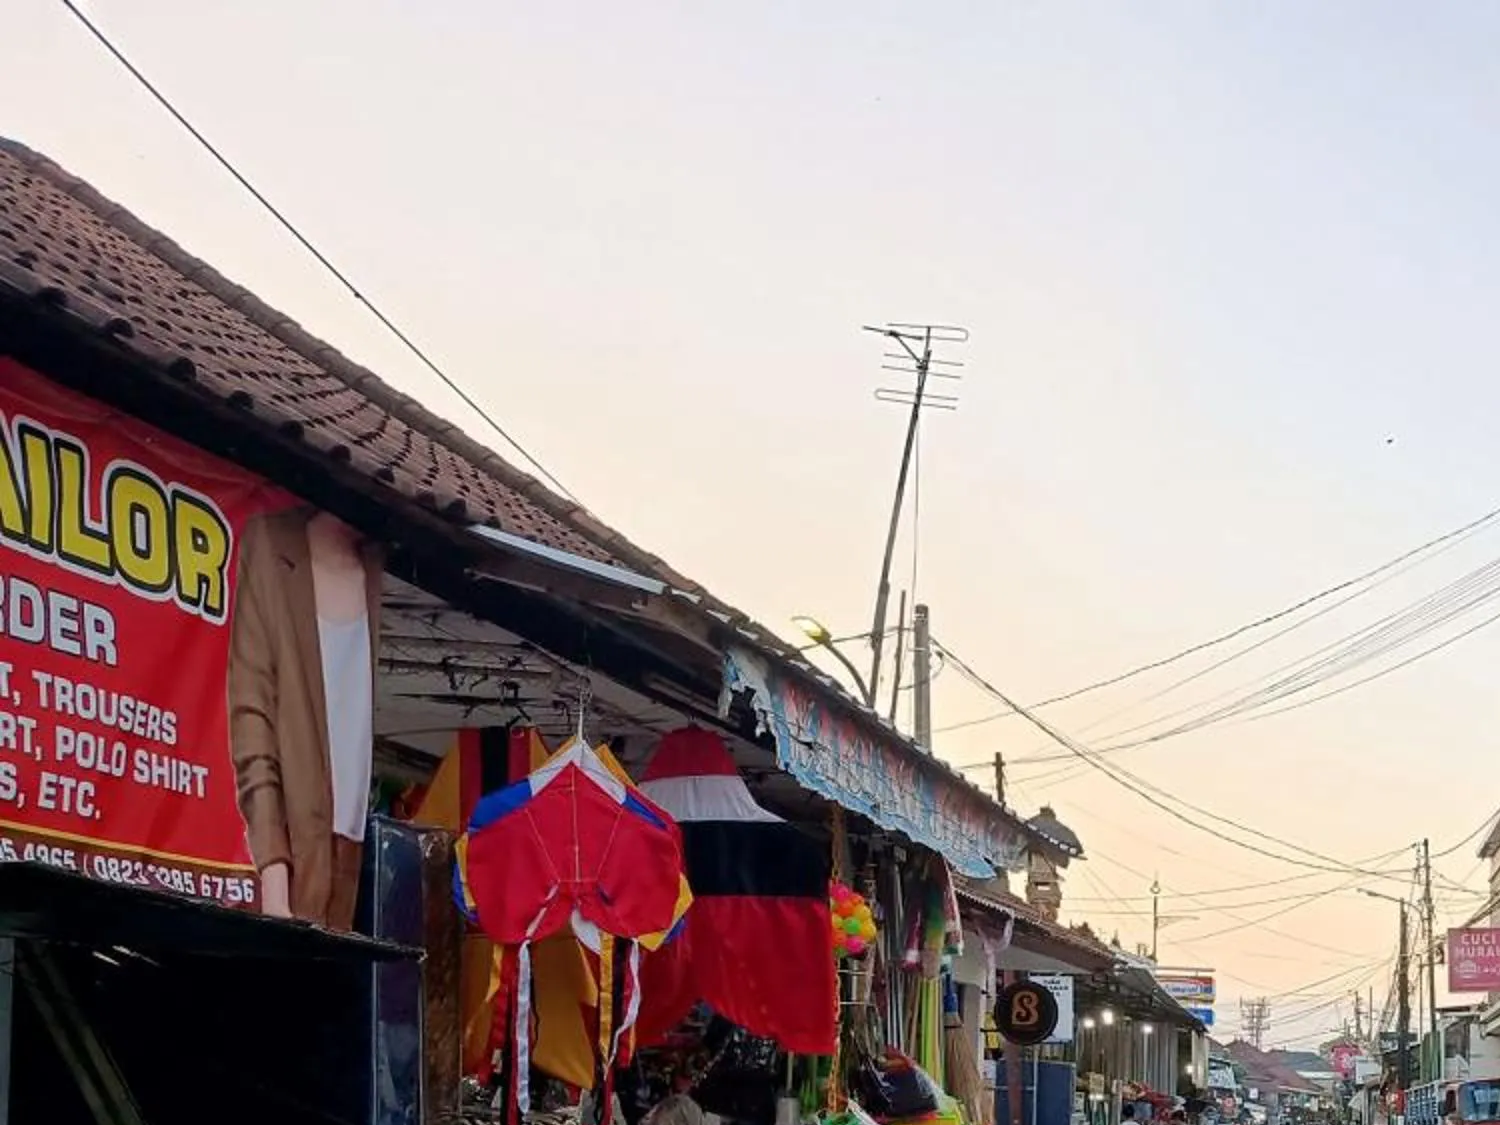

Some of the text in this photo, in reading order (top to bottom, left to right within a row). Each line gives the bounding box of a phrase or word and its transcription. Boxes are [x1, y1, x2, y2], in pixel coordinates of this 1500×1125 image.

[0, 576, 117, 666] DER
[32, 669, 178, 745] TROUSERS
[55, 725, 127, 777] POLO
[133, 749, 209, 798] SHIRT
[201, 874, 254, 902] 6756
[1461, 933, 1496, 945] CUCI
